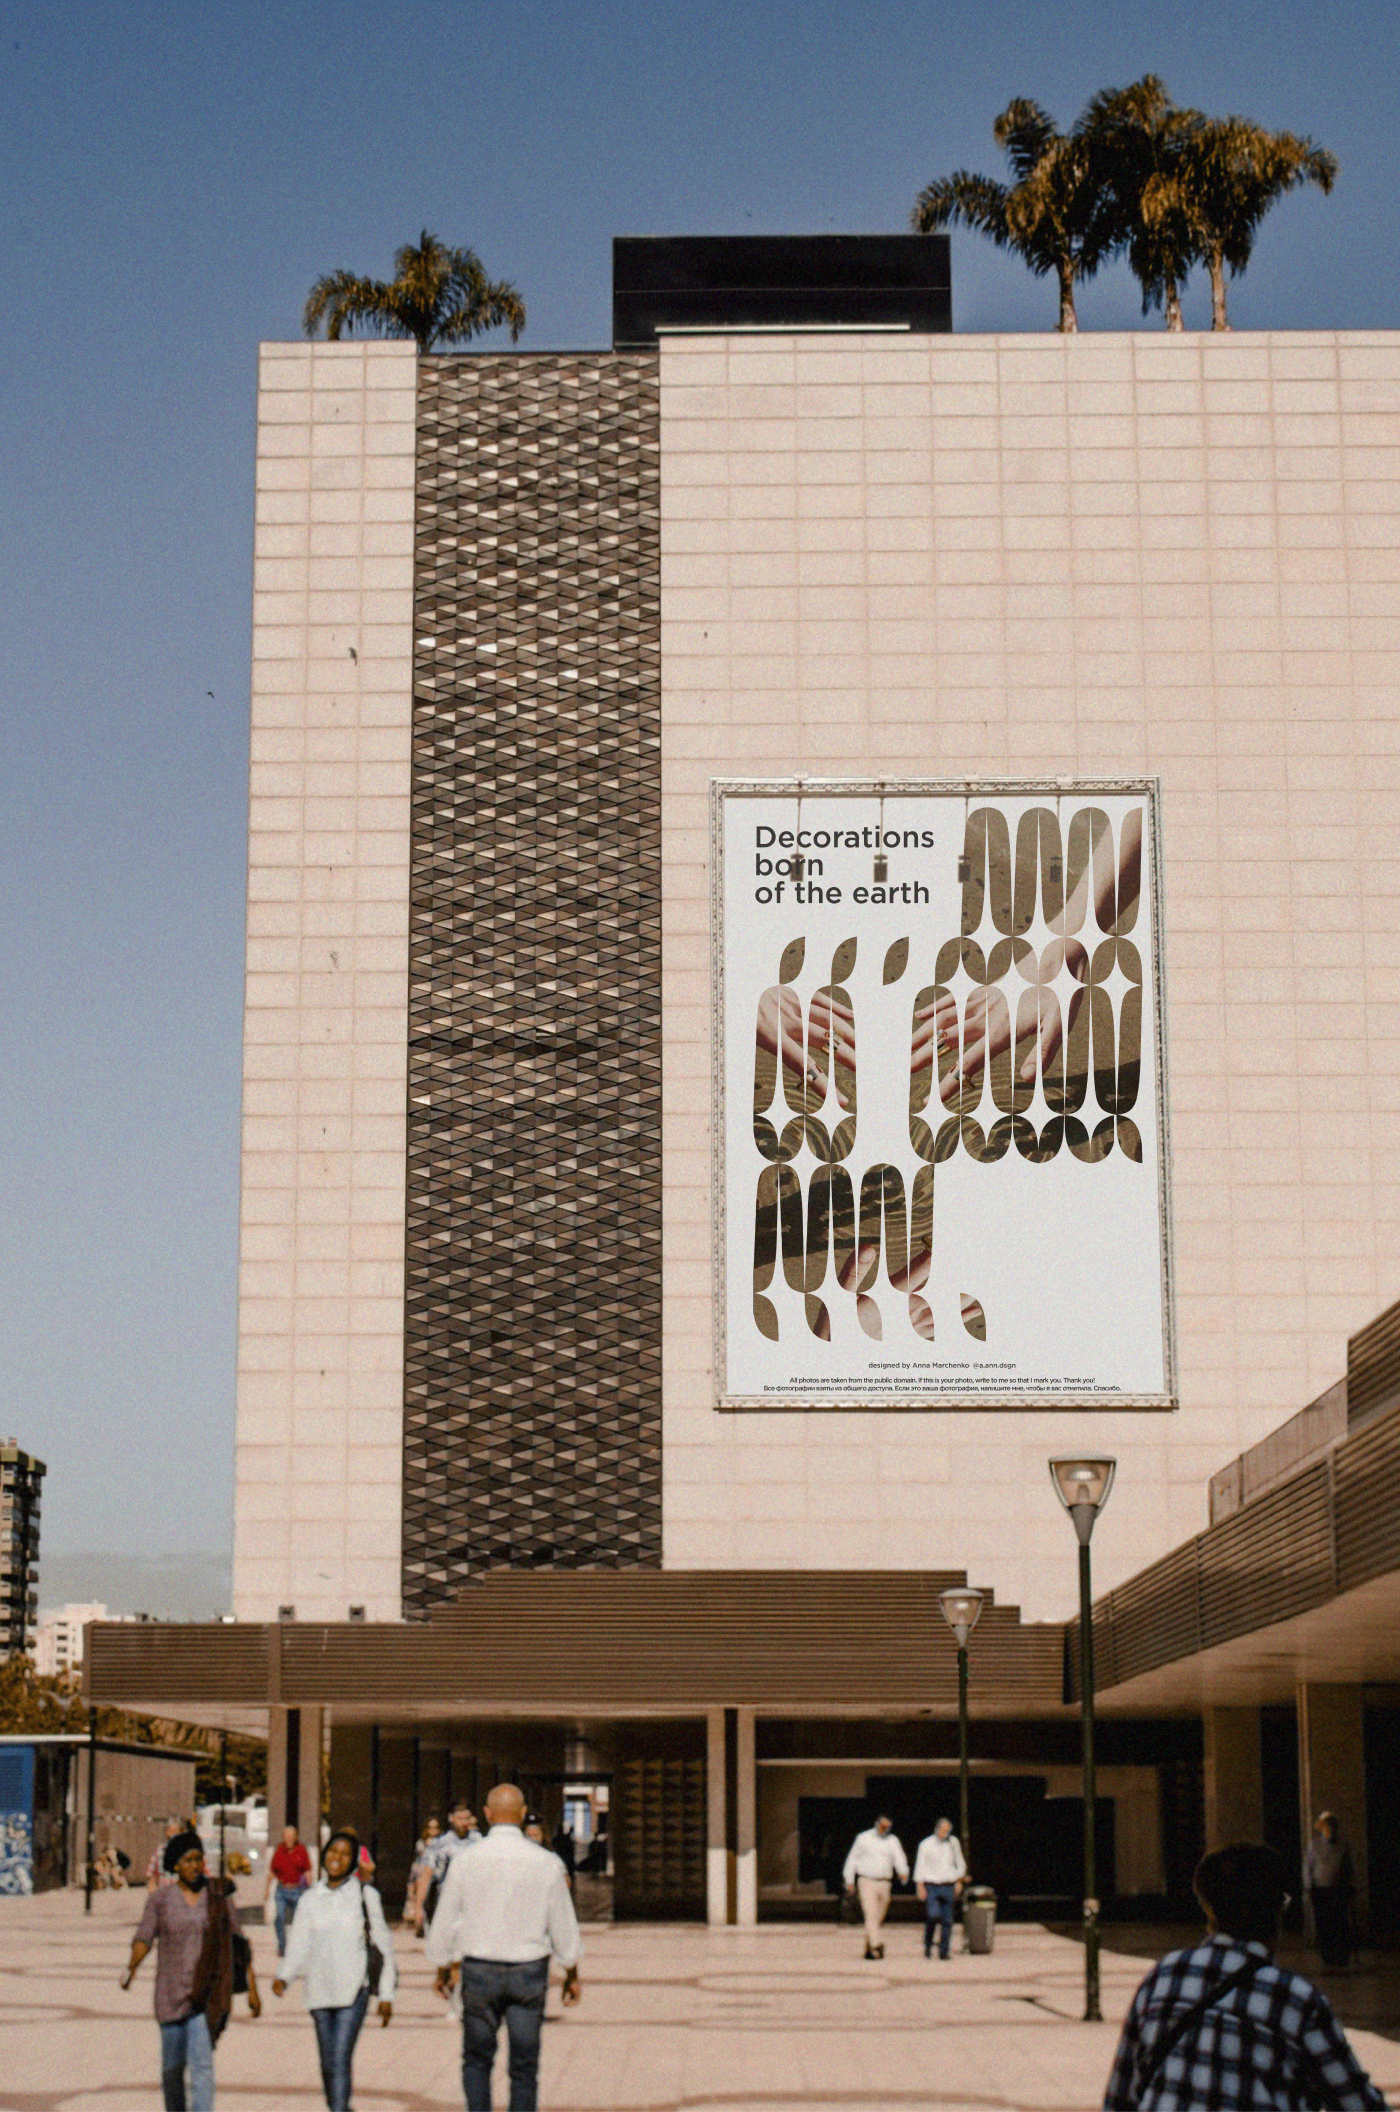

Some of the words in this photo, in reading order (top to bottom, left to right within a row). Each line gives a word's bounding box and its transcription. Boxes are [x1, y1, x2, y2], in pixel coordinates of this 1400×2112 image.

[756, 826, 934, 848] Decorations
[756, 853, 823, 875] born
[755, 881, 785, 904] of
[795, 881, 842, 904] the
[853, 881, 929, 904] earth
